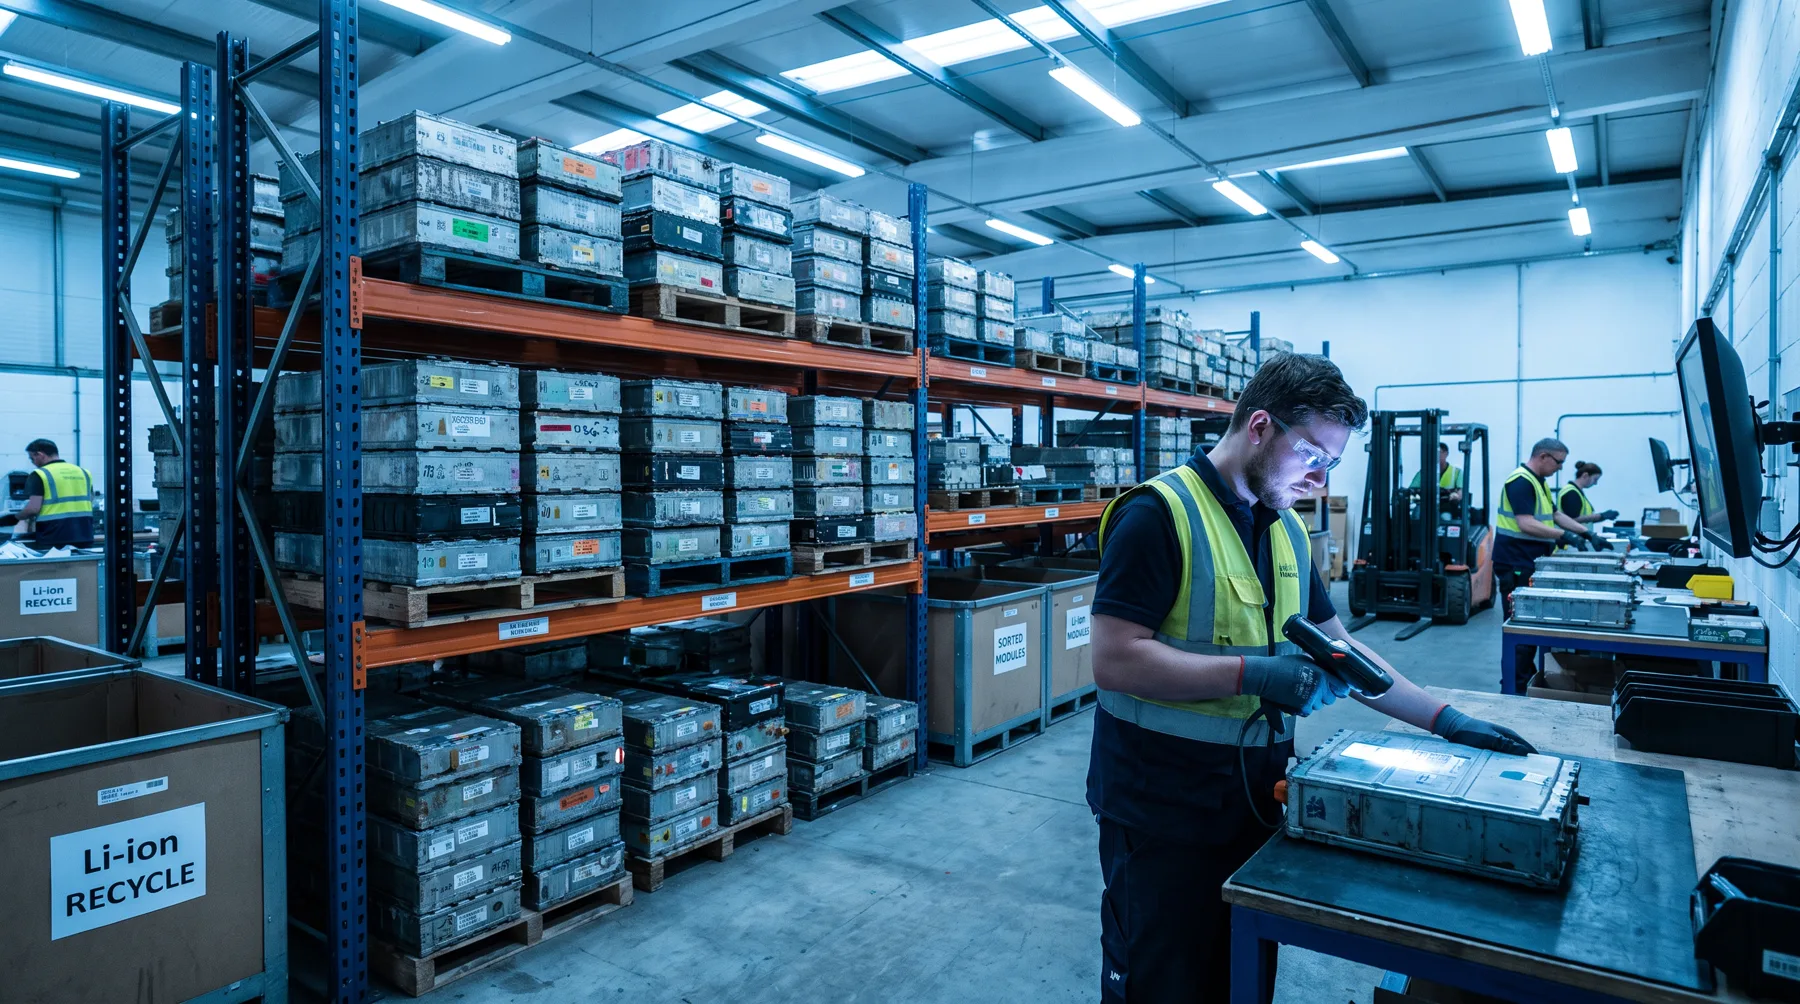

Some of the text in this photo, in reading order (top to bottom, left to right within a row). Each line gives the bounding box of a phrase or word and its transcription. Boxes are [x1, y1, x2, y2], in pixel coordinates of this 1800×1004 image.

[32, 585, 65, 596] Li-ion
[25, 597, 73, 608] RECYCLE
[998, 633, 1024, 648] SORTED
[995, 648, 1026, 665] MODULES
[84, 834, 179, 875] Li-ion
[66, 862, 195, 917] RECYCLE
